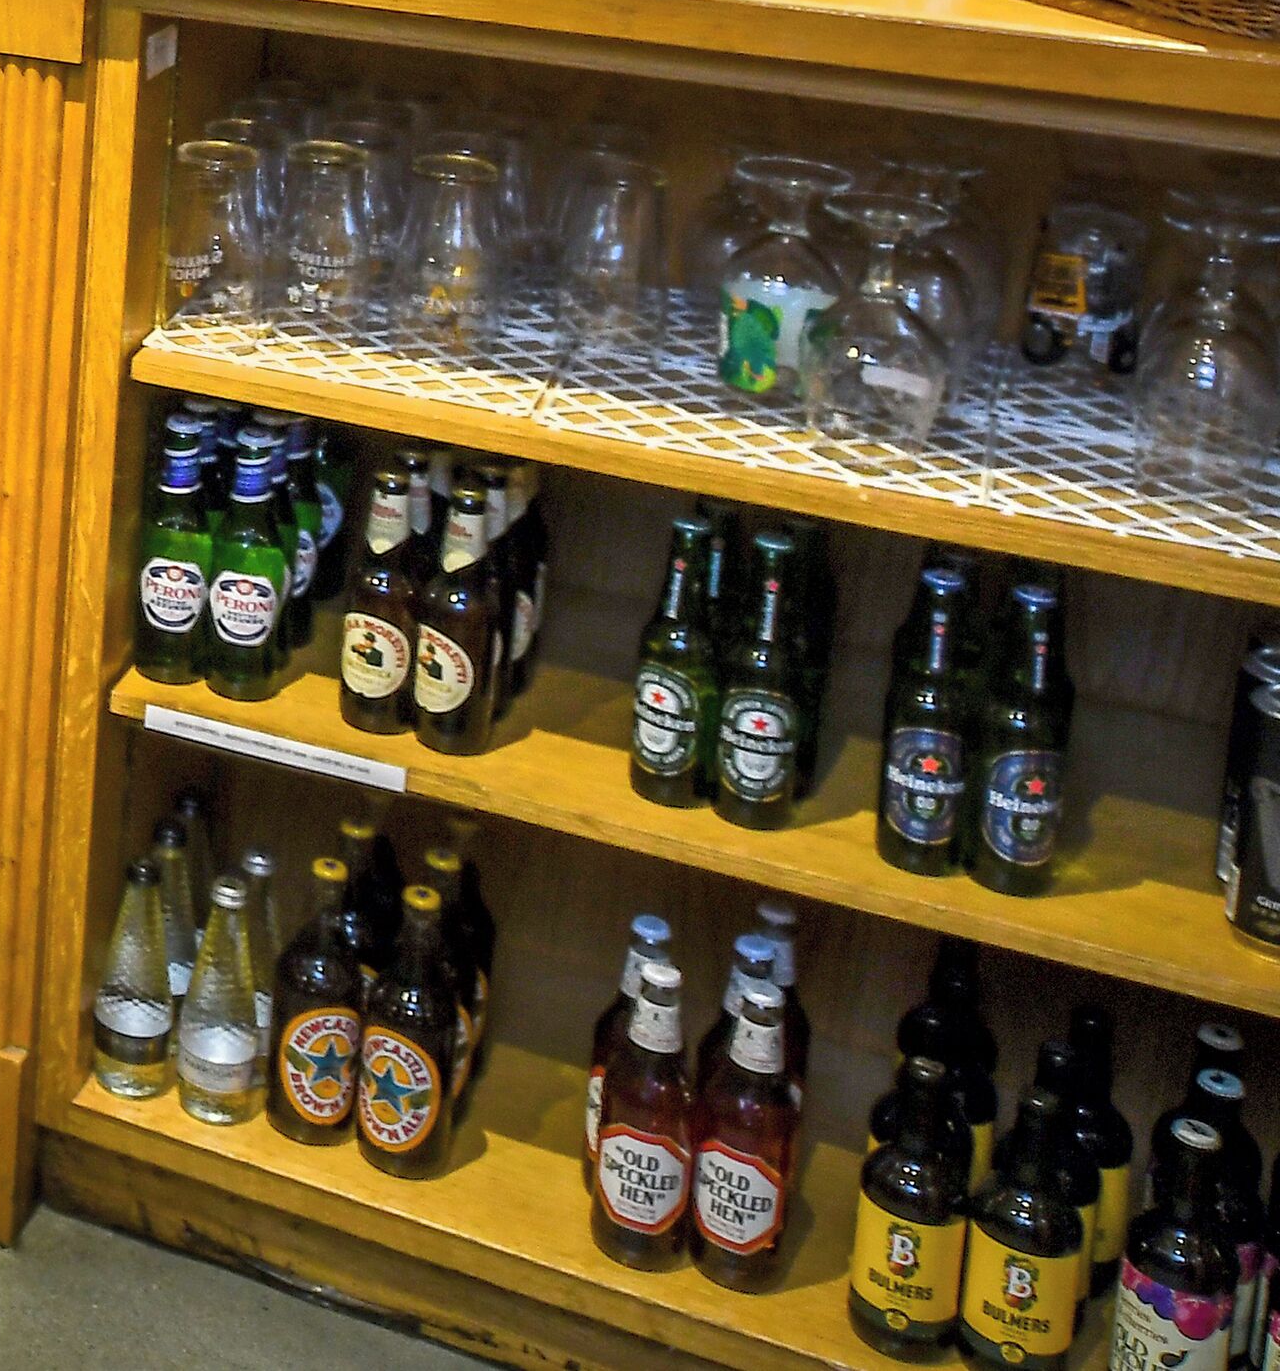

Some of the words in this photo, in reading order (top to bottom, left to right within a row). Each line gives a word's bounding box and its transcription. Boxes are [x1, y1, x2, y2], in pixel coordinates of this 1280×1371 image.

[146, 577, 202, 599] PERONI
[215, 591, 273, 613] PERONI
[891, 1233, 915, 1266] B
[869, 1267, 934, 1301] BULMERS
[1007, 1265, 1033, 1298] B
[983, 1299, 1051, 1334] BULMERS
